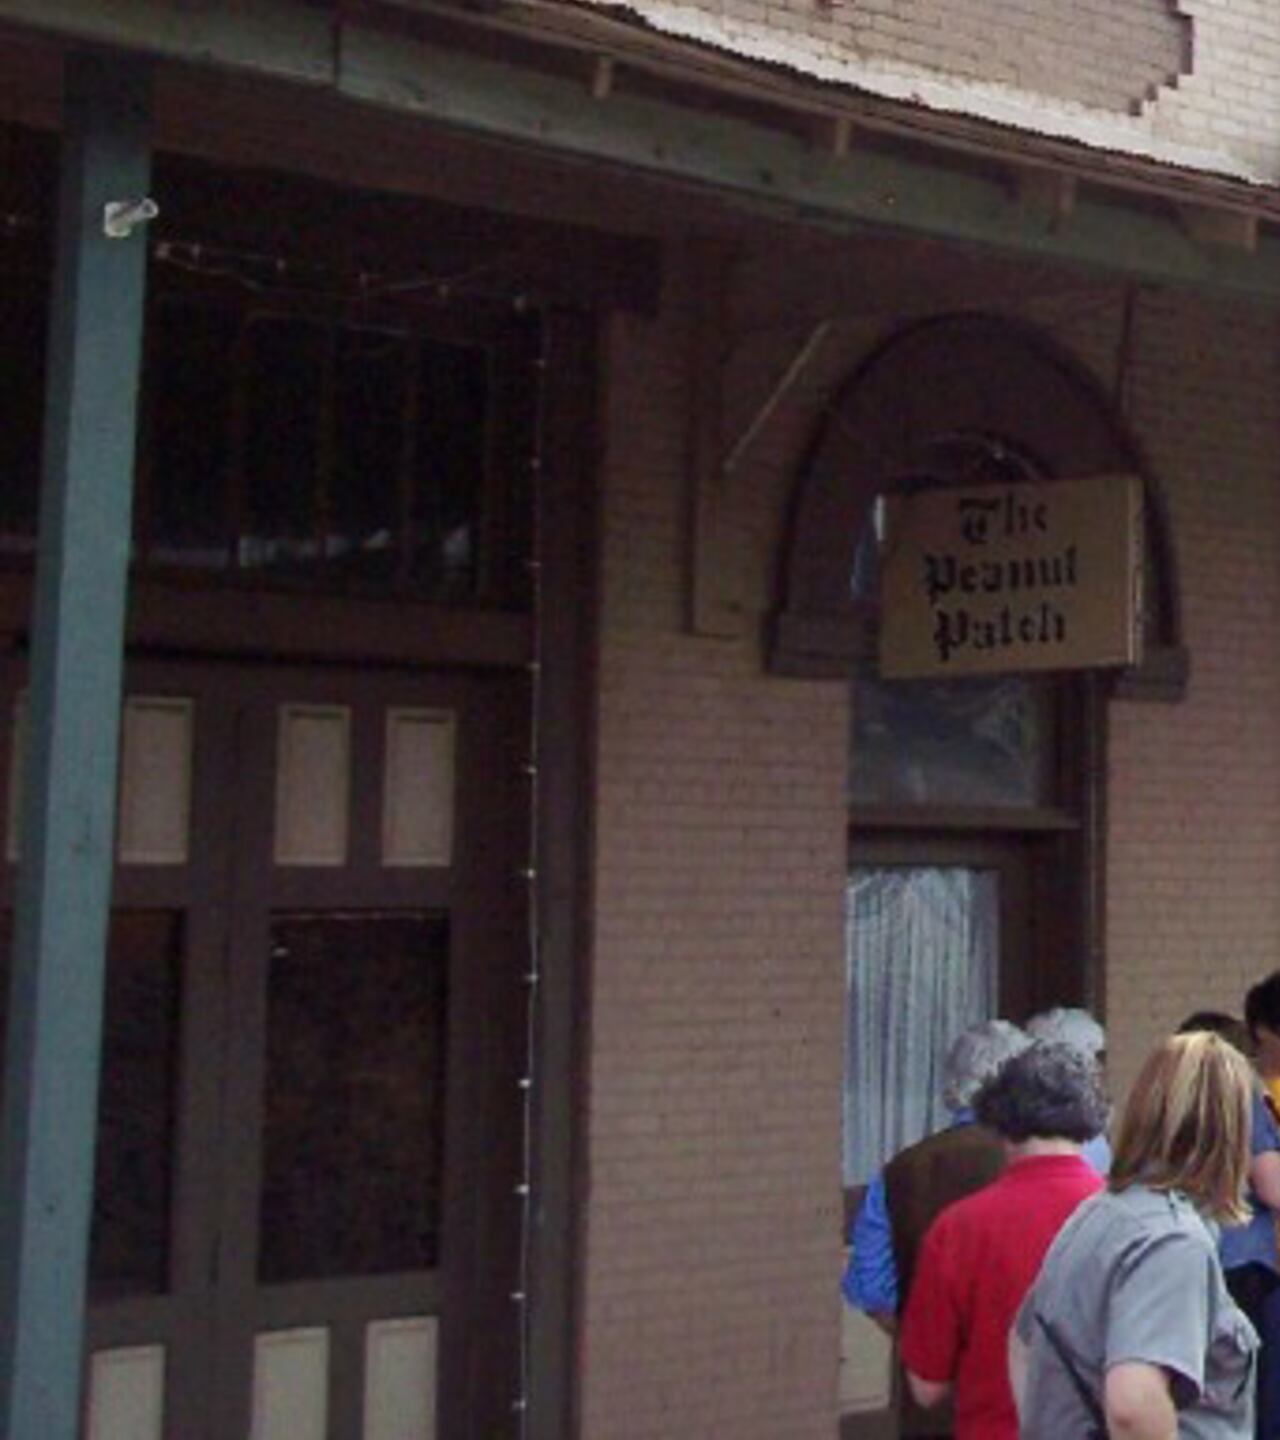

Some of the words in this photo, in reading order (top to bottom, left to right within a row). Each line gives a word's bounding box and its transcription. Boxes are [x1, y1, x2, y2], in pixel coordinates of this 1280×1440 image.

[955, 494, 1049, 545] The
[922, 545, 1078, 604] Peanut
[933, 602, 1066, 662] Patch
